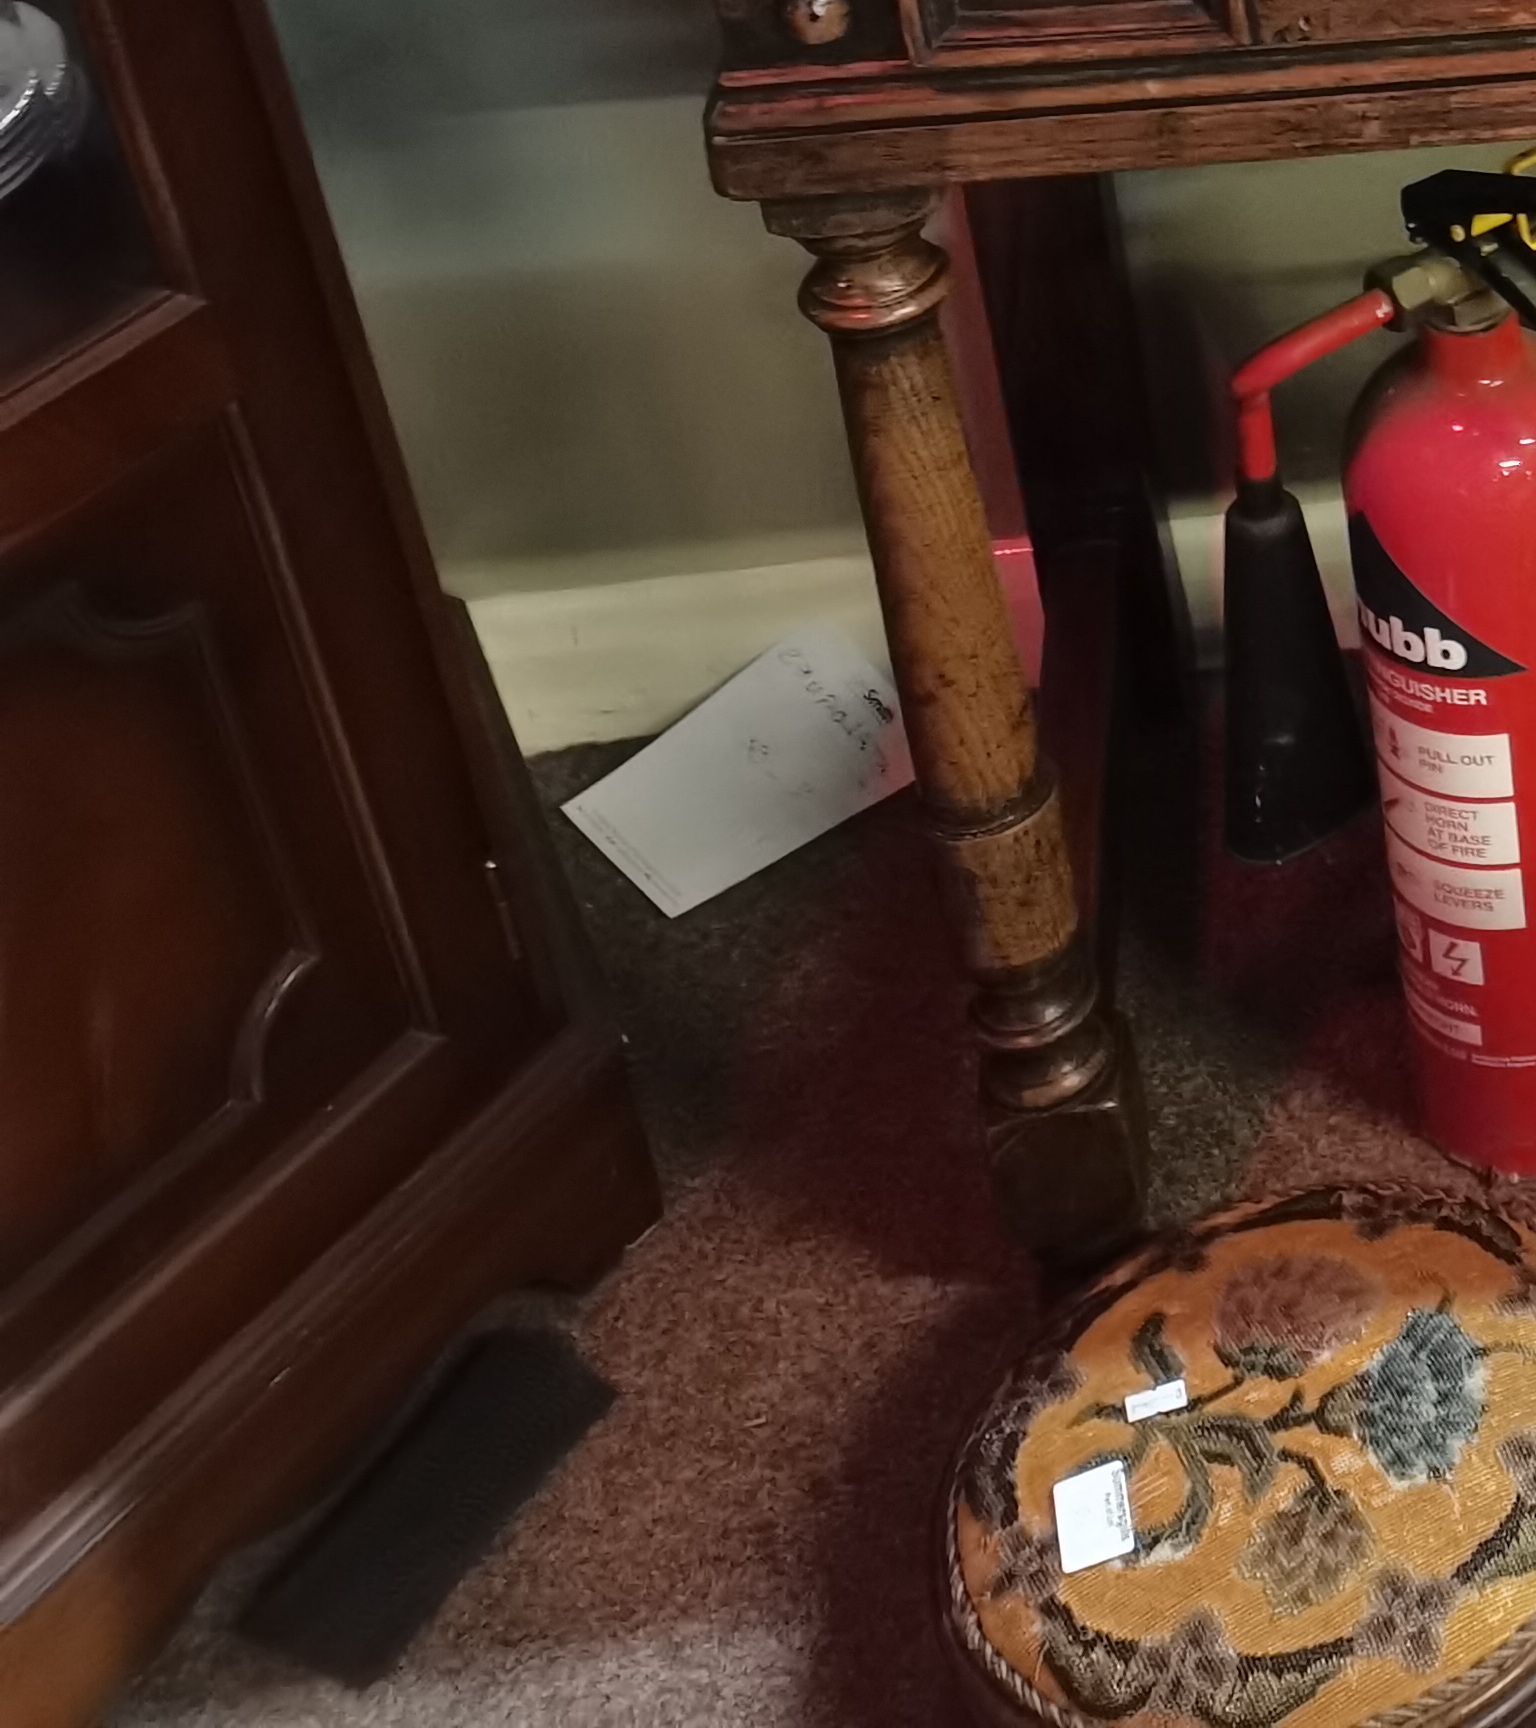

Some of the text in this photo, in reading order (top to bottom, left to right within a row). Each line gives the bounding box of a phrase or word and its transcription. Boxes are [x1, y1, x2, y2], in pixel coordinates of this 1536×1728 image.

[1418, 746, 1494, 766] PULL OUT
[1424, 801, 1479, 821] DIRECT
[1425, 813, 1468, 832] HORN
[1427, 827, 1492, 846] AT BASE
[1451, 846, 1488, 858] FIRE
[1434, 879, 1506, 900] SQUEEZE
[1433, 893, 1494, 912] LEVERS
